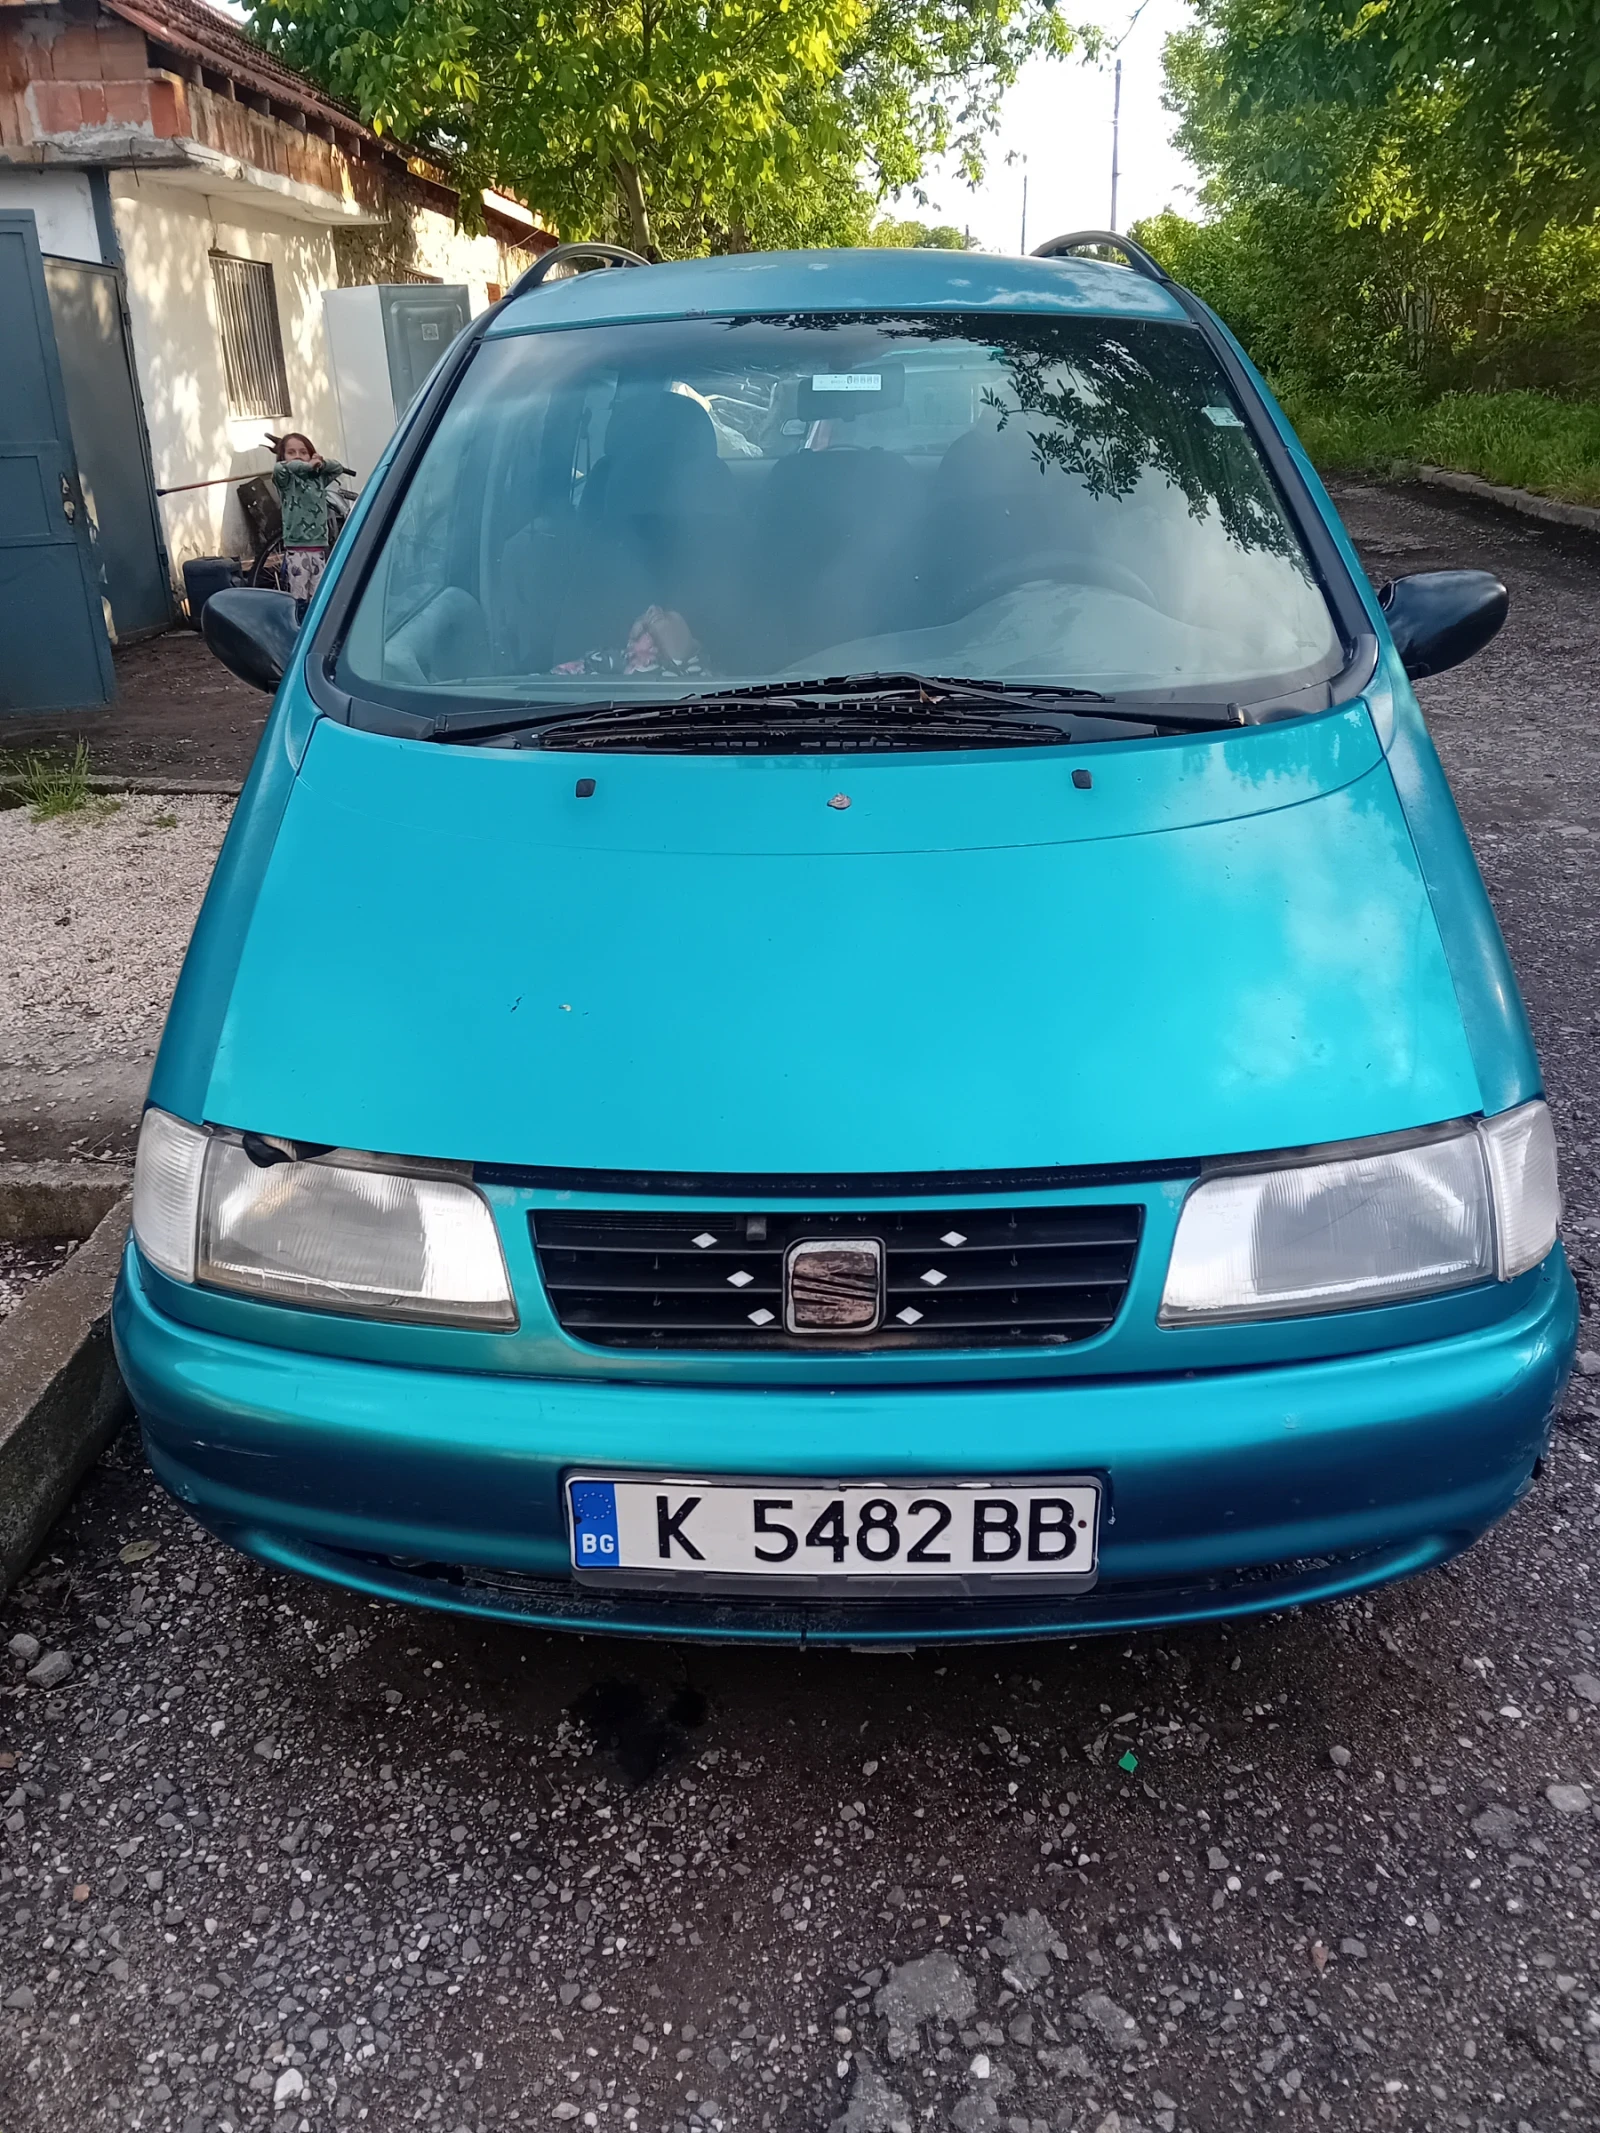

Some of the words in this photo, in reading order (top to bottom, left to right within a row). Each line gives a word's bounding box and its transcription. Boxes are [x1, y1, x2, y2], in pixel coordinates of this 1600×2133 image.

[582, 1533, 614, 1553] BG
[656, 1495, 706, 1560] K
[753, 1499, 952, 1562] 5482
[972, 1498, 1077, 1562] BB
